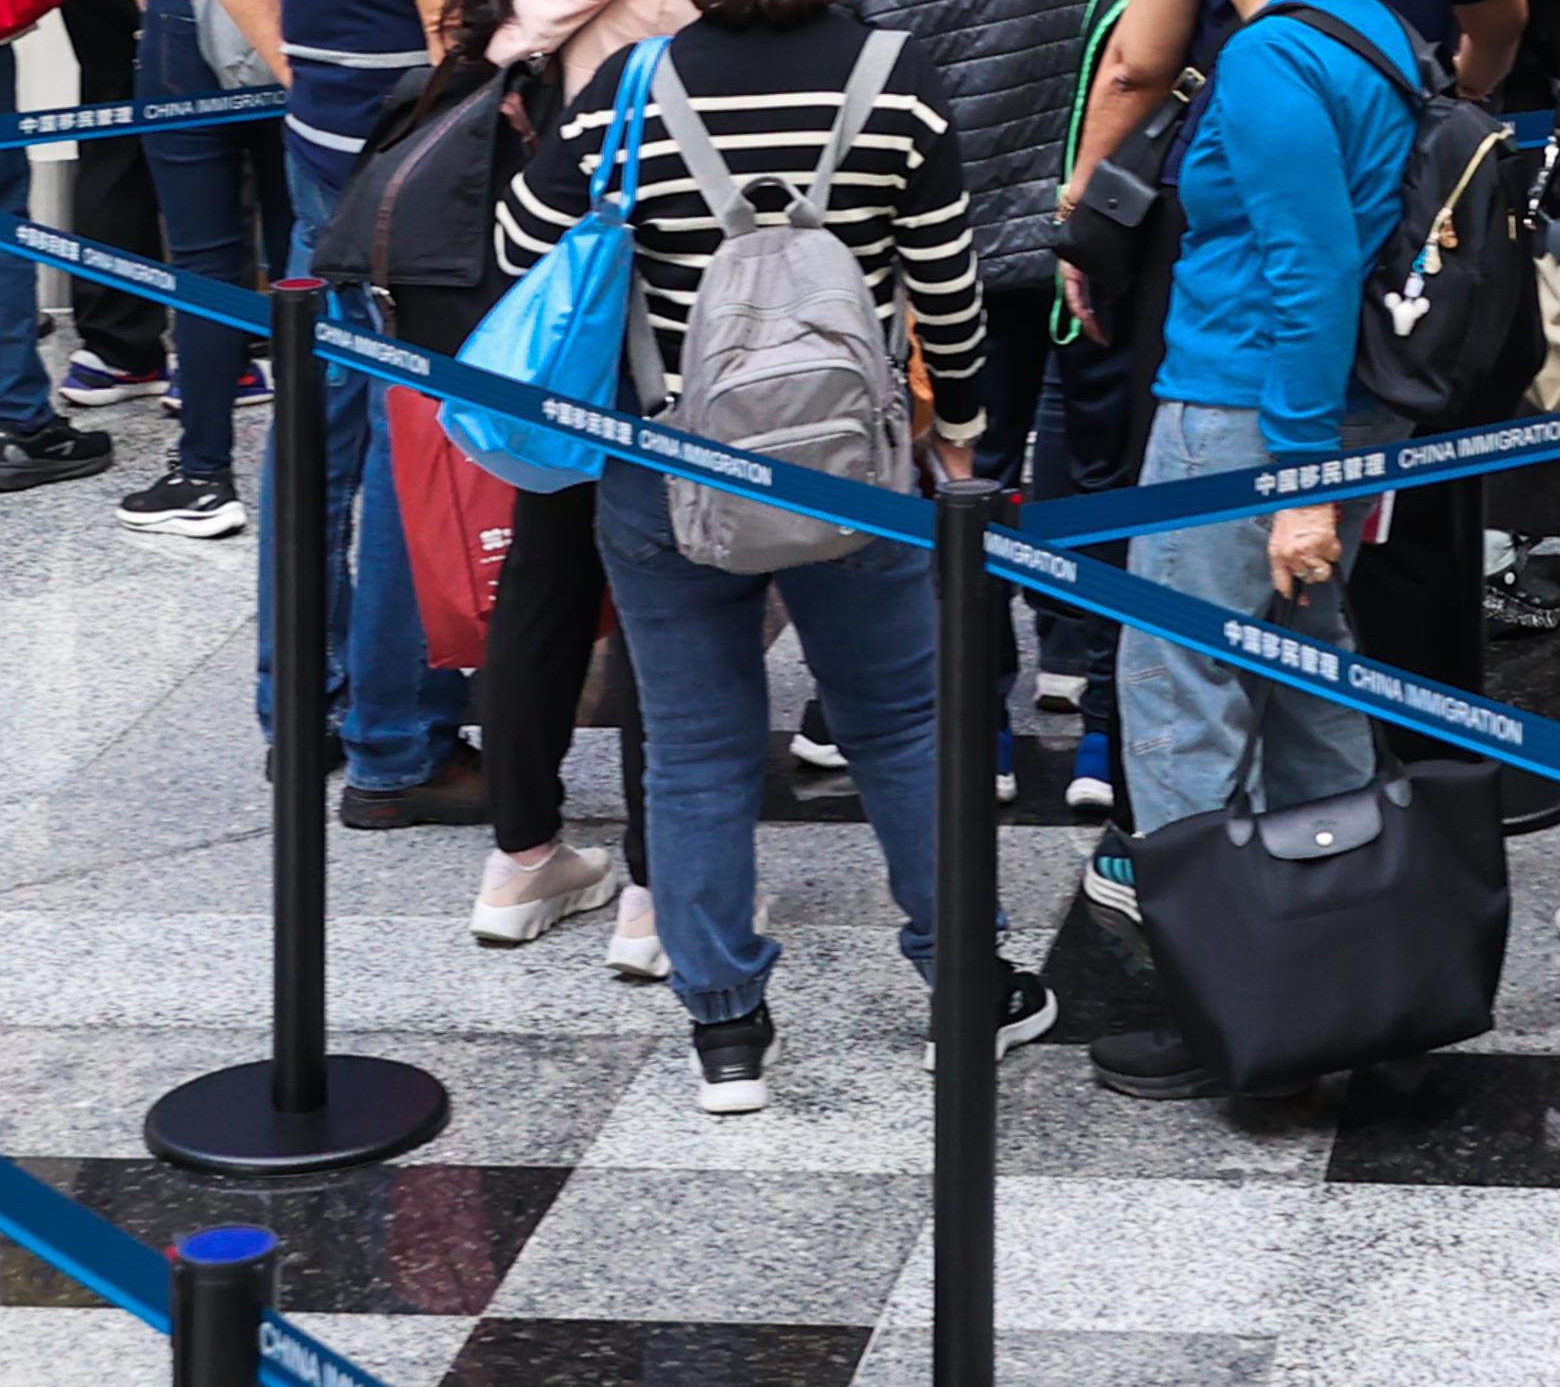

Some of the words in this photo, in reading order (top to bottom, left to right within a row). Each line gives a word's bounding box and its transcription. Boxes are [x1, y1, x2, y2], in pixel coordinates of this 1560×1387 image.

[143, 100, 196, 120] CHINA
[638, 428, 683, 461] CHINA
[681, 440, 773, 488] IMMIGRATION
[1255, 452, 1386, 497] 中国移民管理
[1397, 439, 1455, 470] CHINA
[1223, 619, 1340, 683] 中国移民管理
[1349, 662, 1403, 704] CHINA
[1403, 681, 1524, 747] IMMIGRATION
